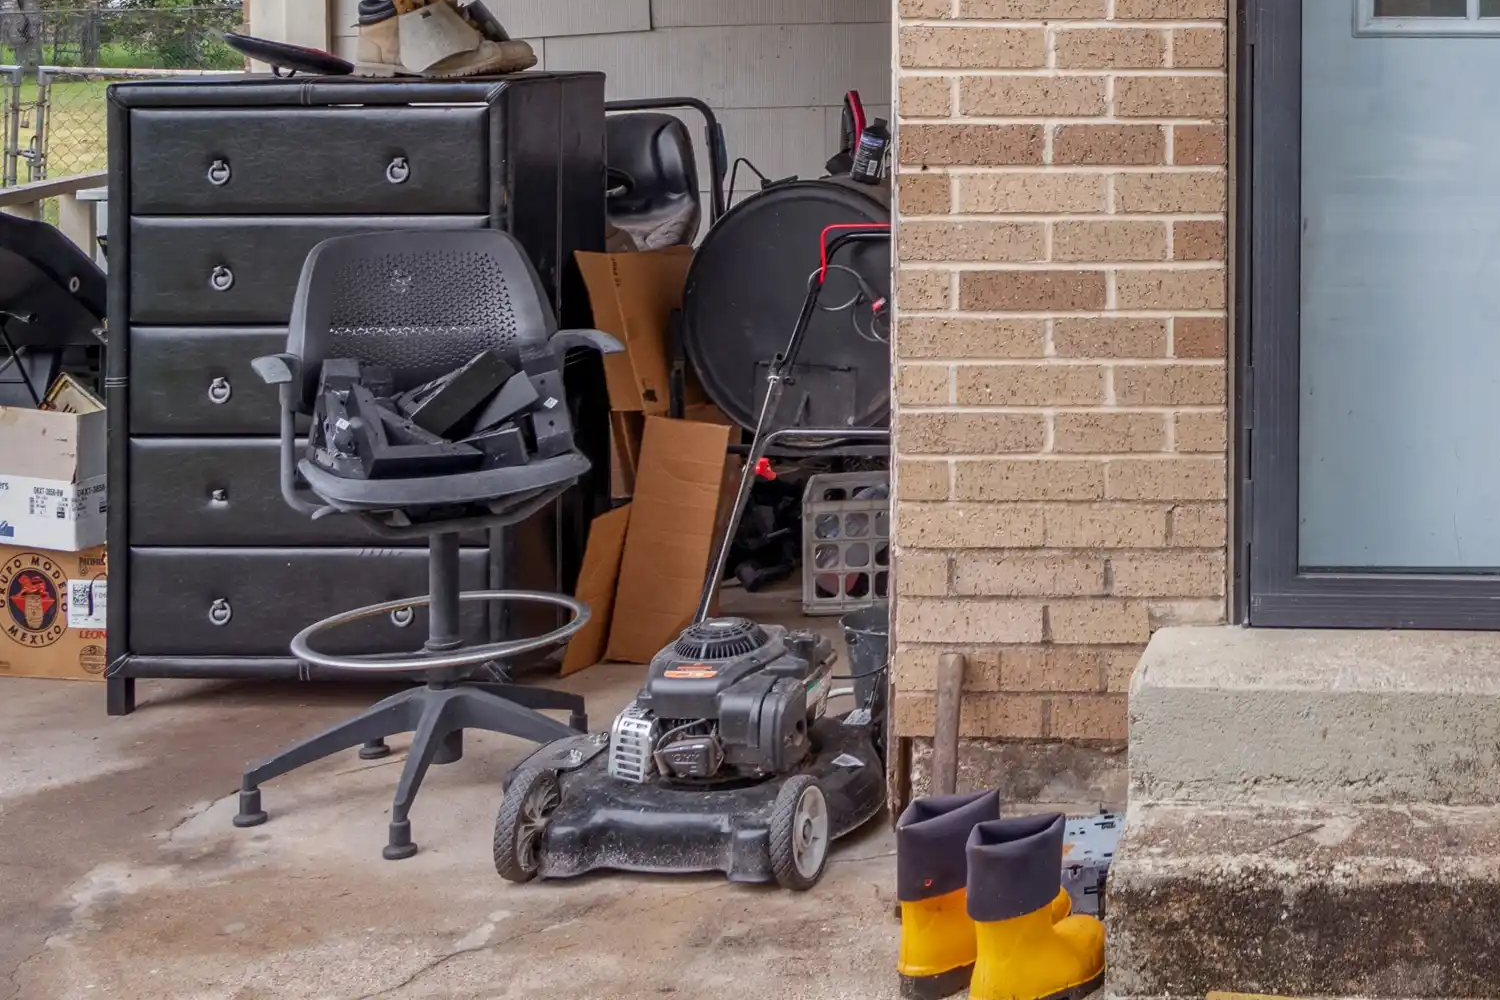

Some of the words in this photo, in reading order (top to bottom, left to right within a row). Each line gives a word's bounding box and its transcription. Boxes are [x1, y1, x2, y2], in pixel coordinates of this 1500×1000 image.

[0, 559, 22, 608] GRUPO
[31, 555, 68, 613] MODELO
[8, 625, 62, 645] MEXICO
